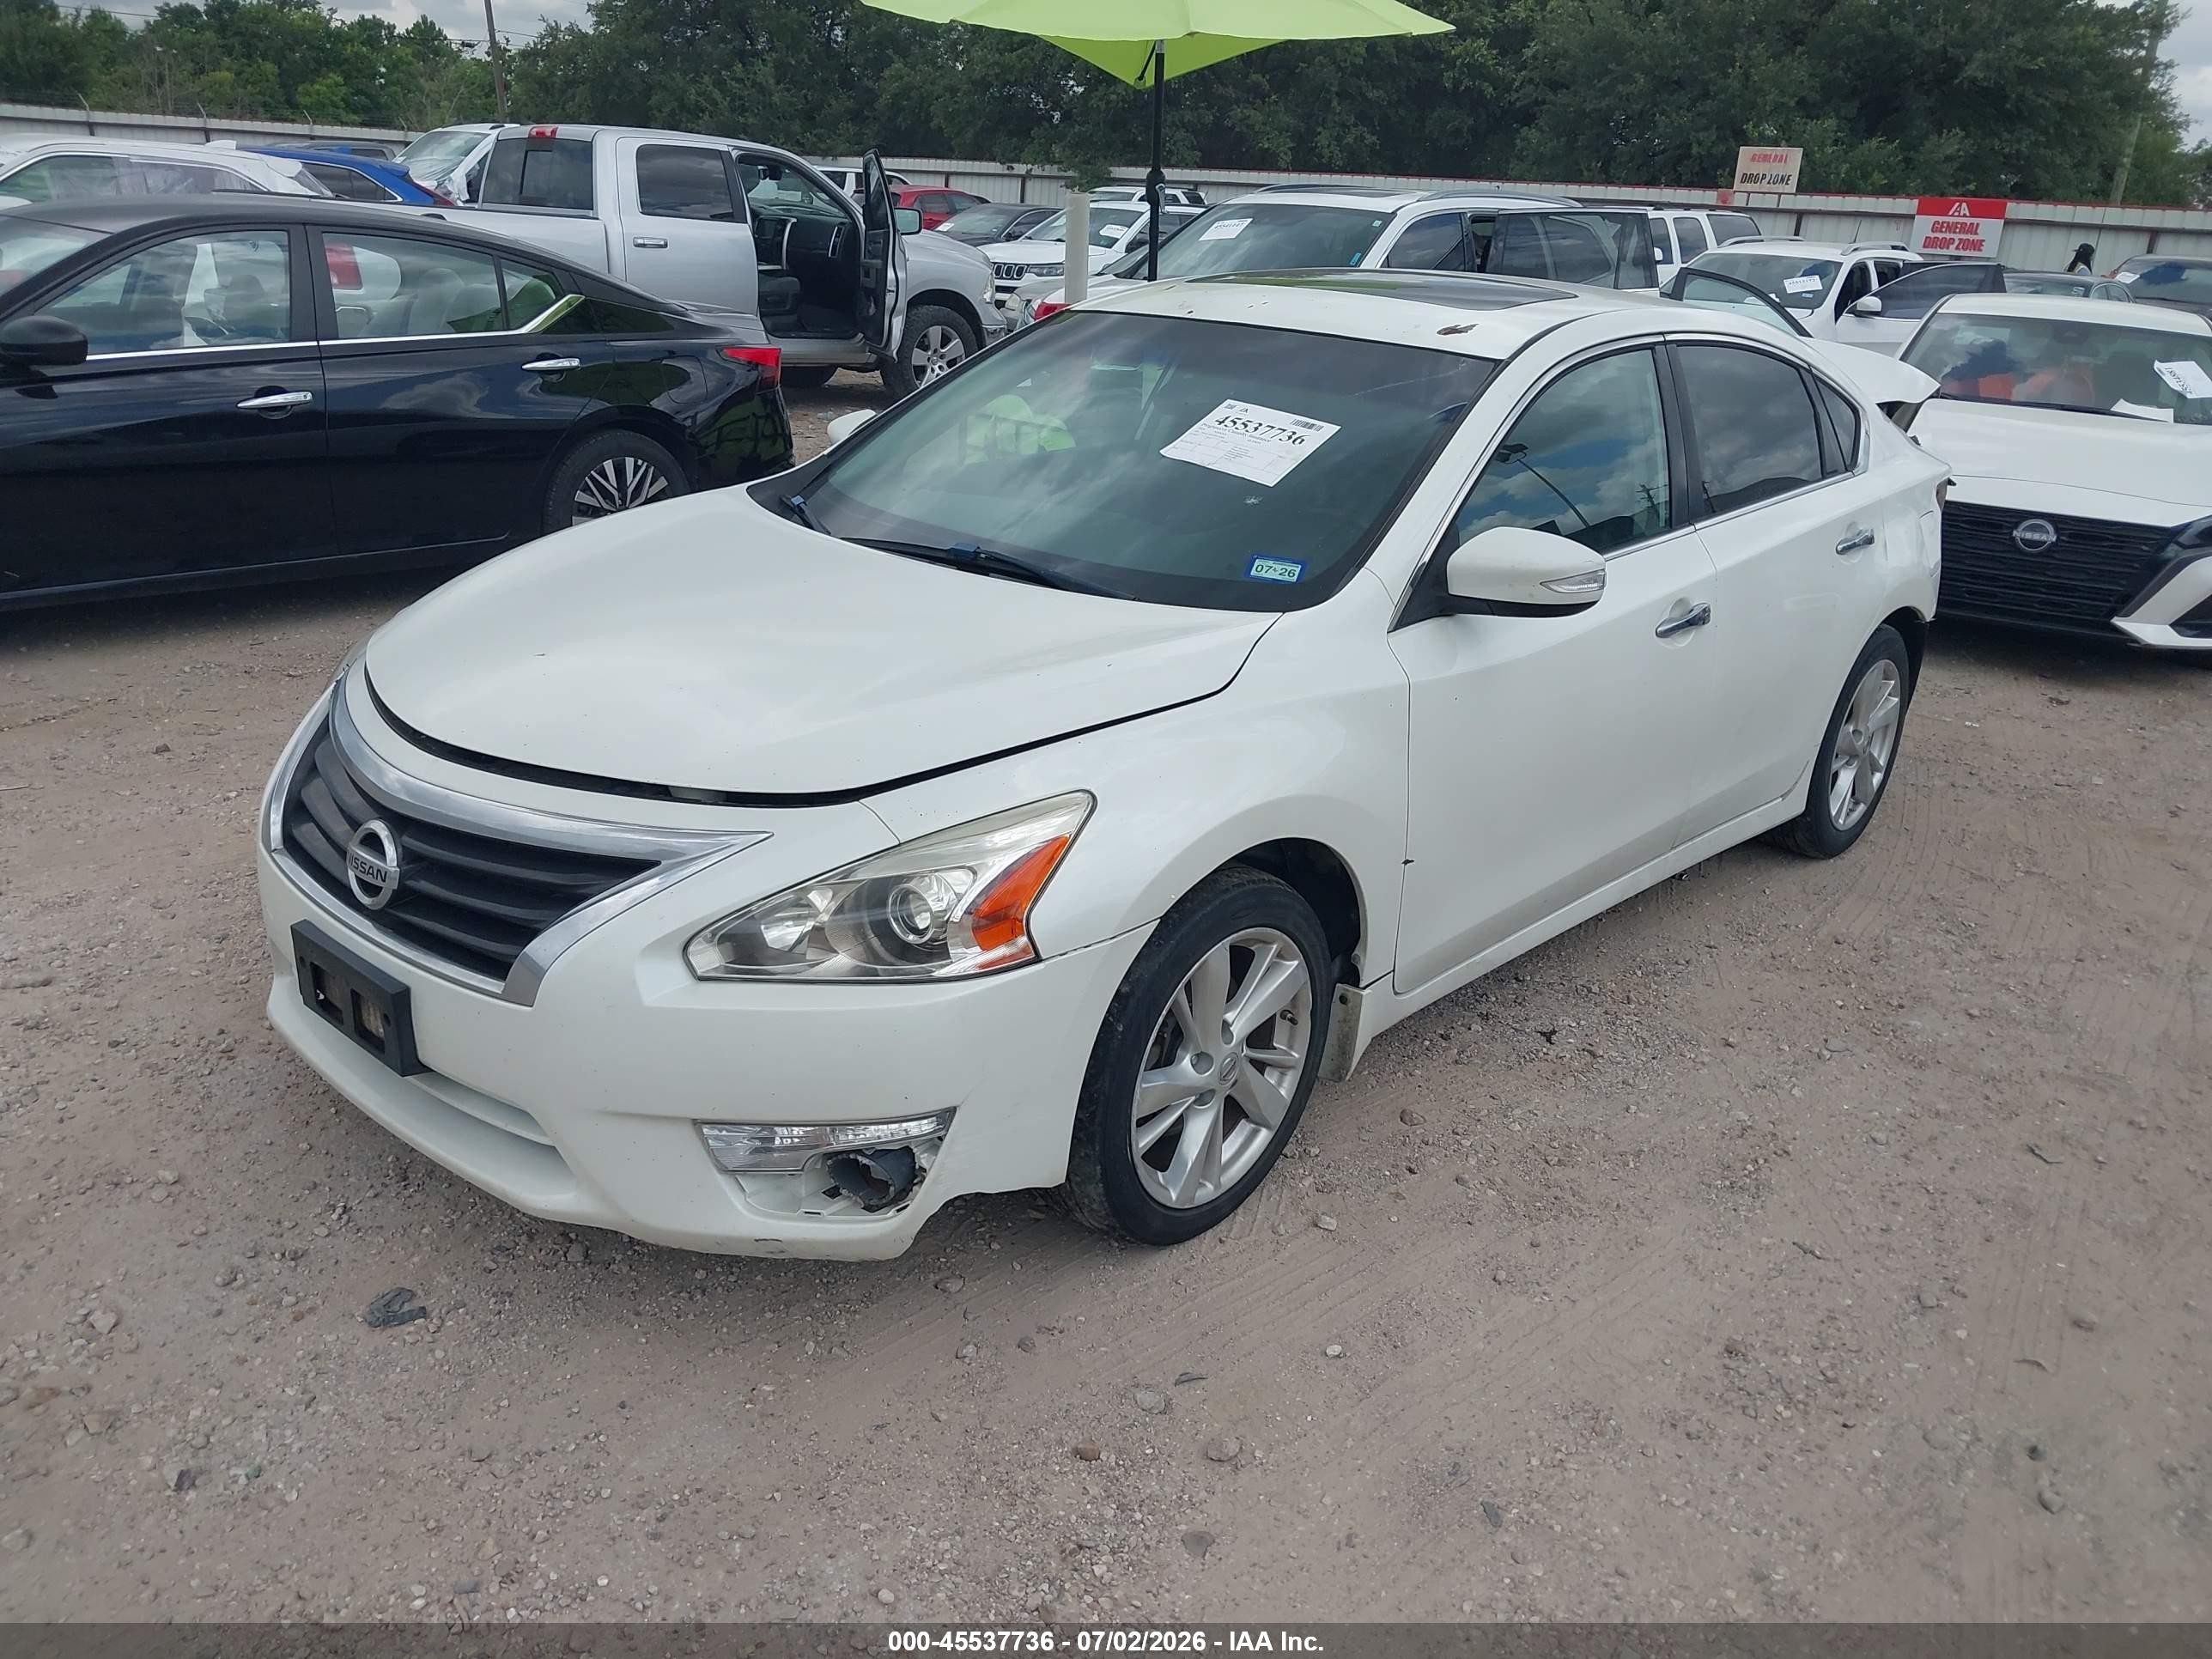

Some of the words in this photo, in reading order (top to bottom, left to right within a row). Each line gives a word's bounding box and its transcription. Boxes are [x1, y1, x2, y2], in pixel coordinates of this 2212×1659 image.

[1740, 173, 1767, 185] DROP
[1931, 221, 1979, 235] GENERAL
[1923, 236, 1955, 250] DROP
[1955, 239, 1985, 252] ZONE
[1215, 416, 1311, 445] 45537736
[2013, 530, 2057, 542] NISSAN
